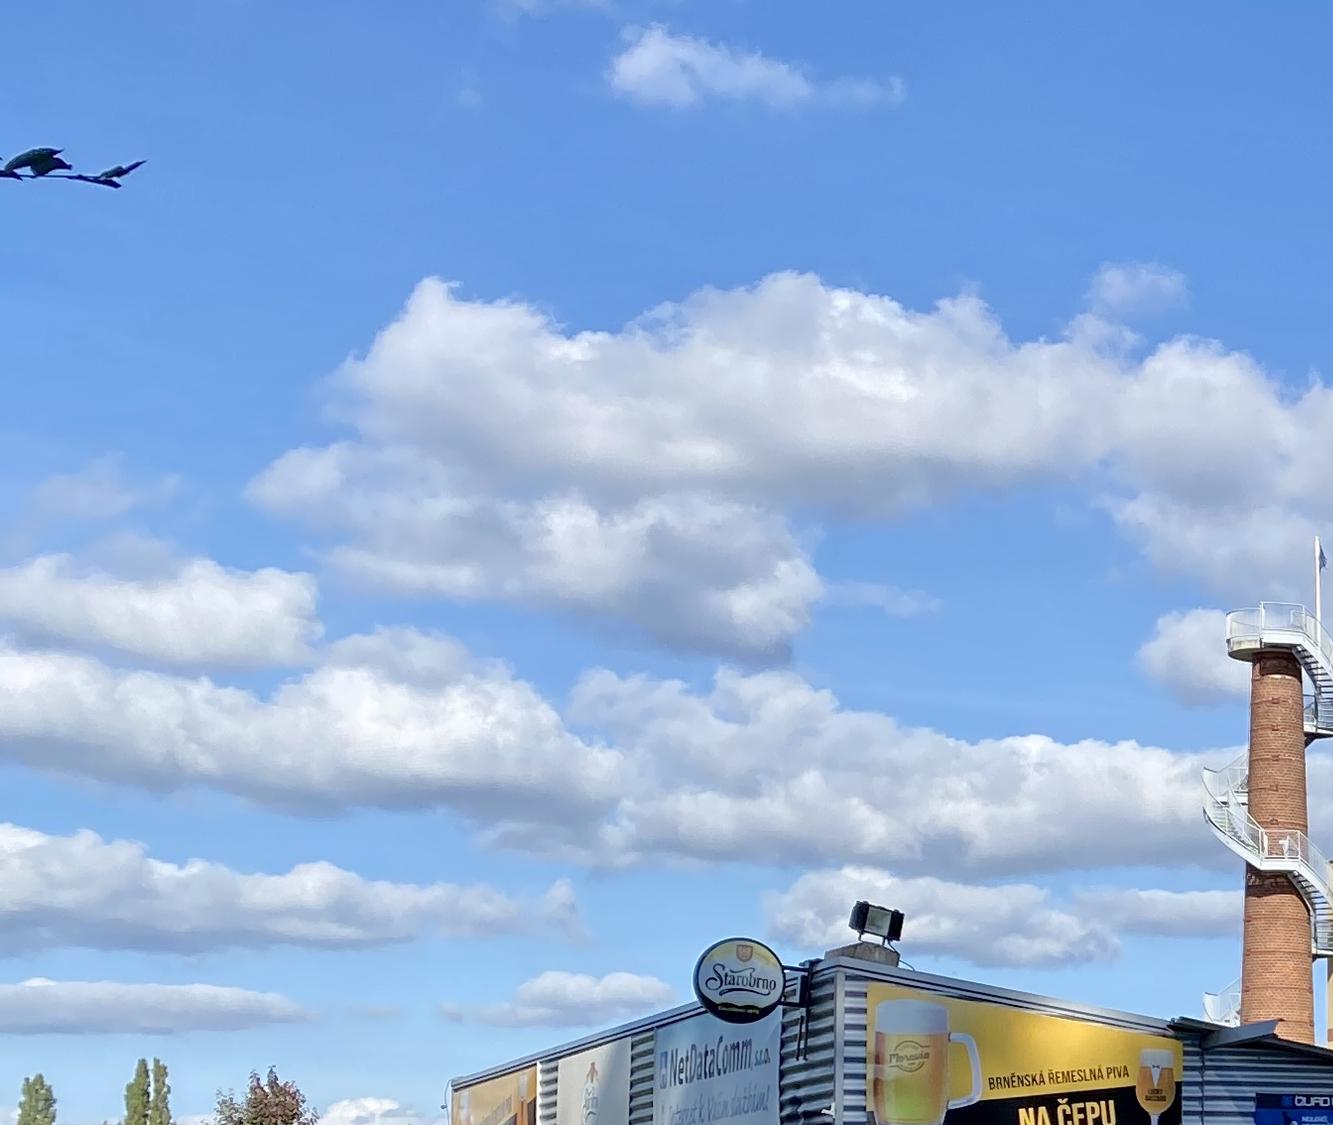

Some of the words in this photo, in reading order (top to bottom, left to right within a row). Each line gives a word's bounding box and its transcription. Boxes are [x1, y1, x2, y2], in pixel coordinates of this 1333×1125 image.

[705, 963, 777, 996] Starobrno
[988, 1067, 1045, 1090] BRNĚNSKÁ
[1048, 1063, 1104, 1084] ŘEMESLNÁ
[1107, 1064, 1130, 1080] PIVA
[1295, 1095, 1330, 1107] QUAD
